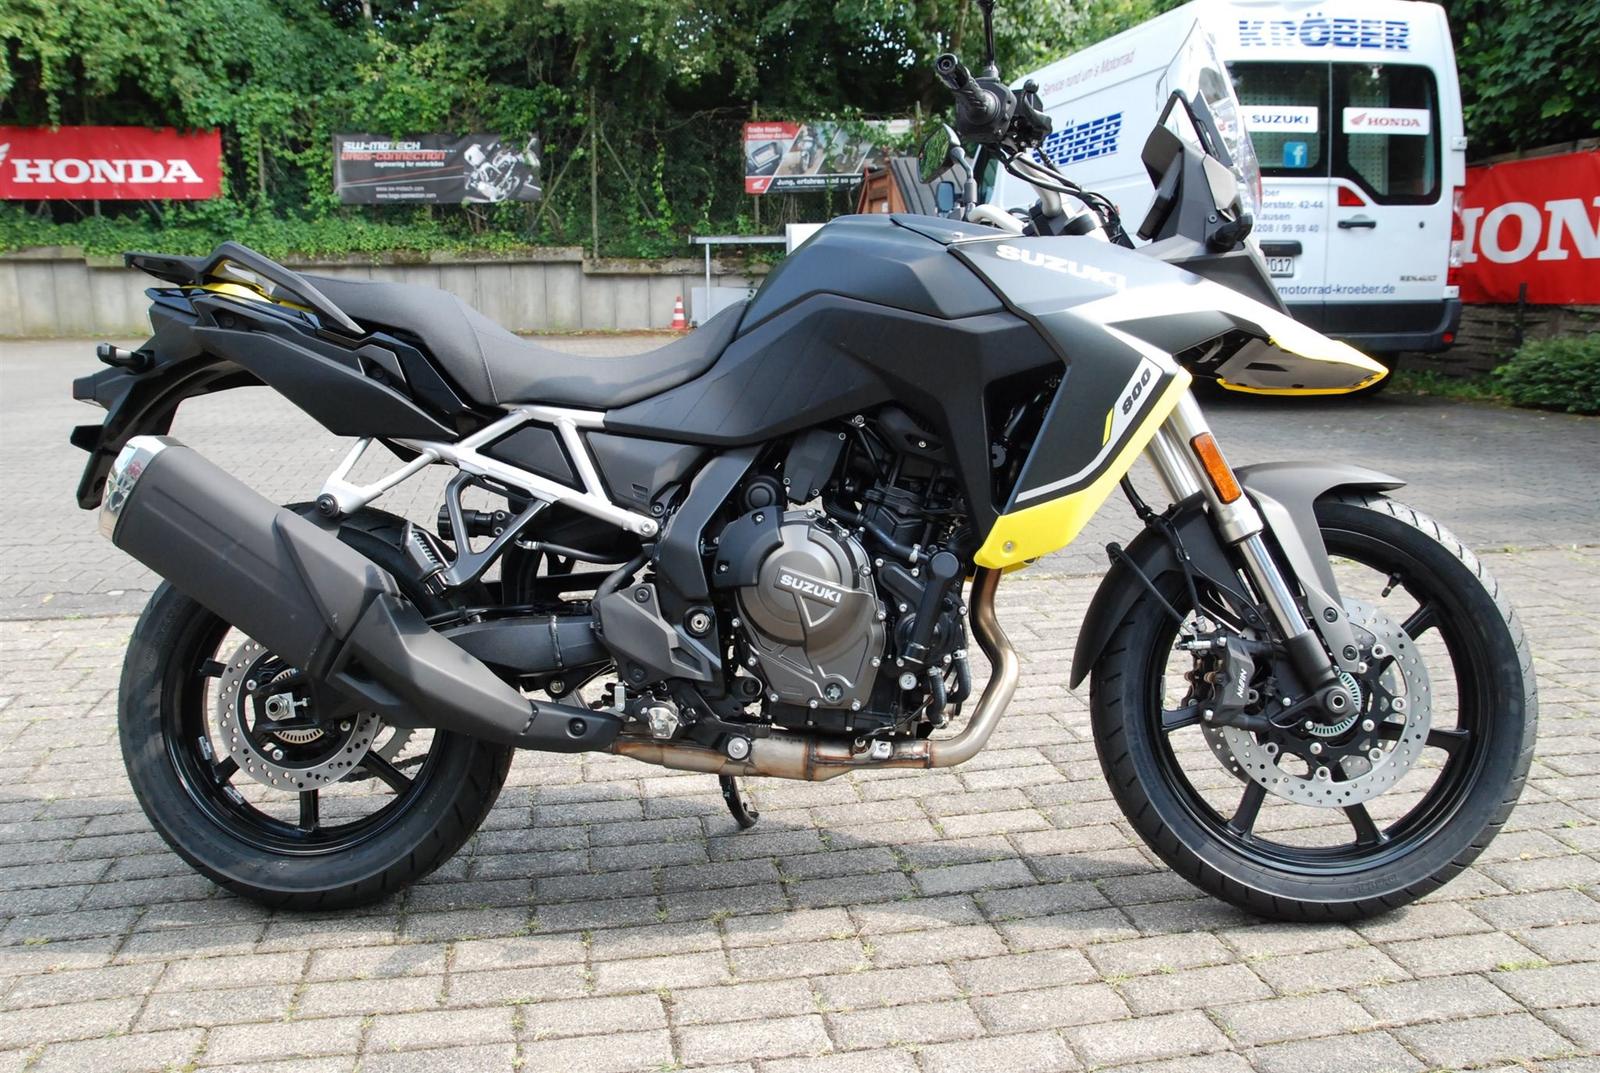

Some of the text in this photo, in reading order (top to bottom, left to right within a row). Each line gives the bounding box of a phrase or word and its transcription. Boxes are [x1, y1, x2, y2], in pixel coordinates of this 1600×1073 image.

[1239, 12, 1410, 50] KRÖBER
[1252, 114, 1309, 124] SUZUKI
[1367, 117, 1421, 127] HONDA
[10, 158, 203, 184] HONDA
[995, 244, 1127, 289] SUZUKI
[1121, 367, 1152, 416] 800
[780, 573, 842, 604] SUZUKI
